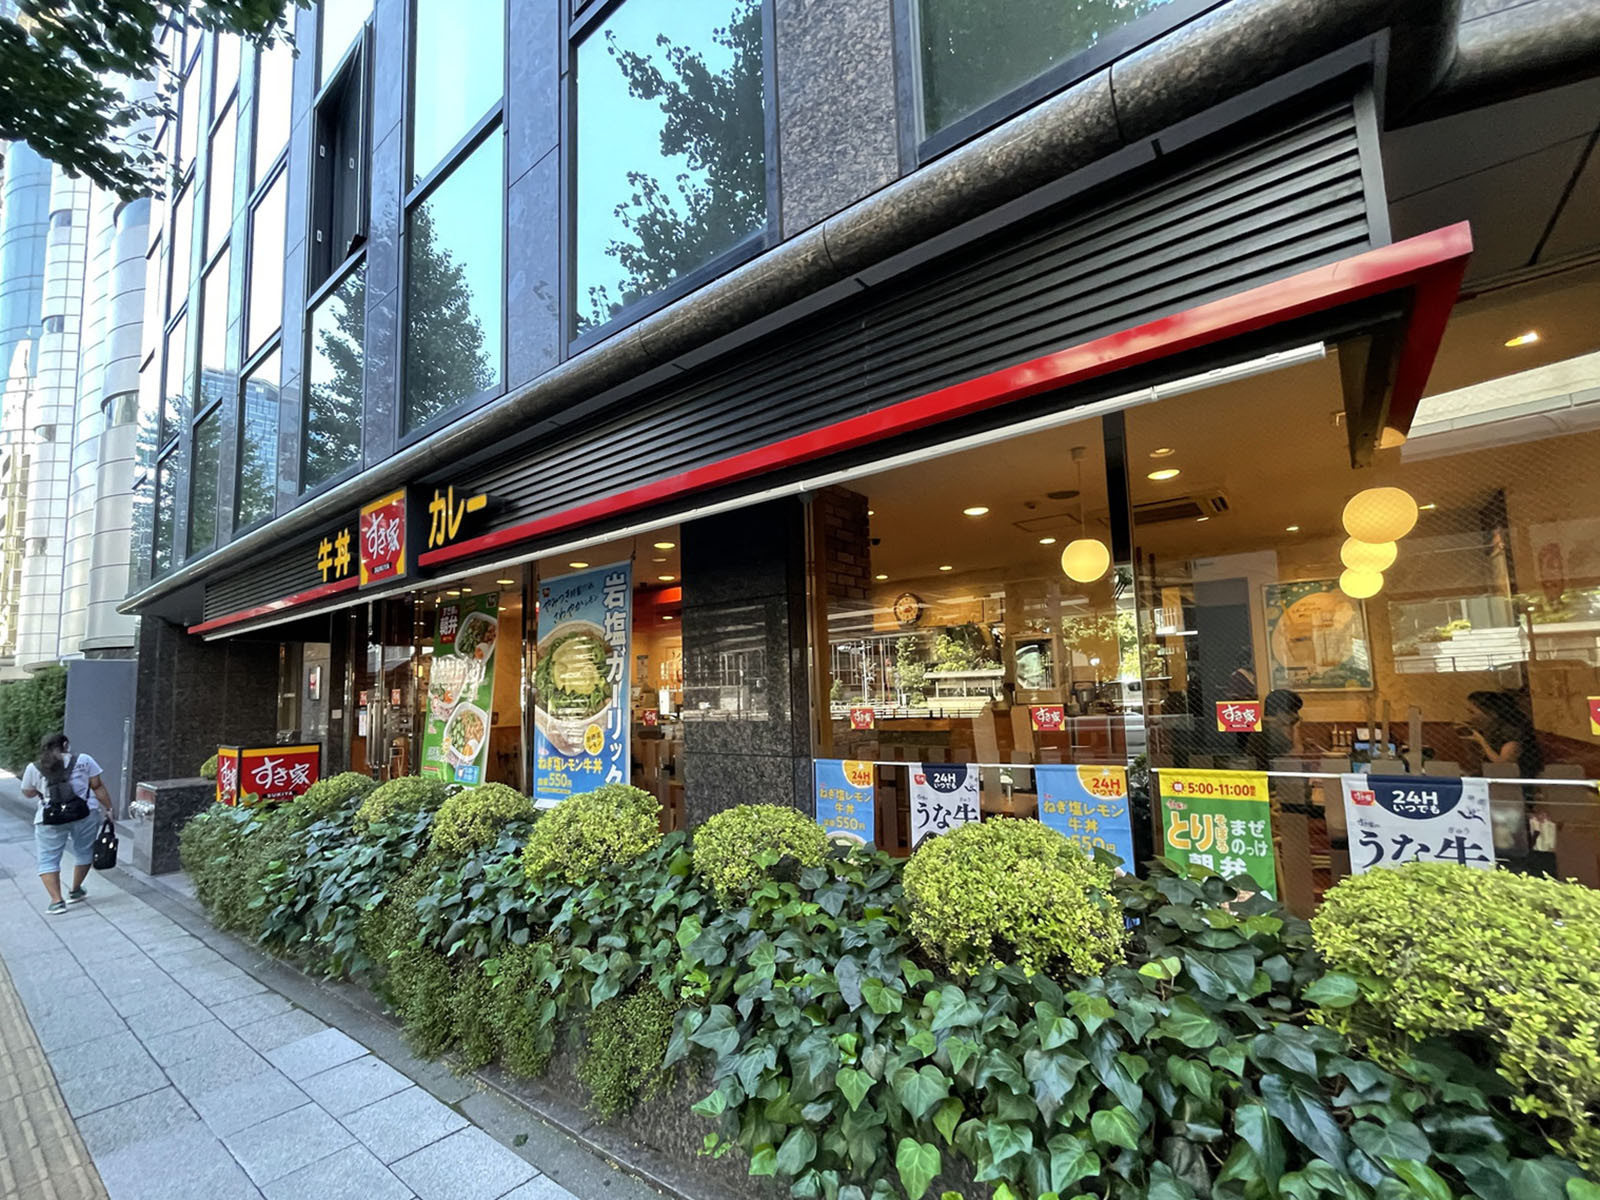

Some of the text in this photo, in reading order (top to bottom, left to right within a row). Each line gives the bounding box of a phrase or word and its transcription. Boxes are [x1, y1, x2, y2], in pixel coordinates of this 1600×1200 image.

[428, 485, 487, 549] カレー
[366, 512, 400, 561] すき家
[317, 528, 351, 583] 牛丼
[603, 572, 627, 784] 岩塩ガーリック
[1036, 707, 1062, 723] すき家
[1221, 704, 1256, 725] すき家
[251, 756, 311, 790] すき家
[537, 757, 604, 774] ねぎ塩レモン牛丼
[853, 770, 871, 780] 24H
[933, 773, 956, 783] 24H
[933, 782, 957, 790] いつでも
[1091, 777, 1121, 790] 24H
[1187, 782, 1249, 796] 5:00-11:00
[267, 790, 293, 799] SUKIYA
[819, 788, 872, 803] ねぎ塩レモン
[1091, 788, 1122, 797] いつでも
[1392, 790, 1438, 805] 24H
[834, 802, 855, 815] 牛丼
[917, 801, 979, 829] うな牛
[1043, 801, 1125, 818] ねぎ塩レモン
[1392, 804, 1440, 814] いつでも
[1068, 817, 1099, 834] 牛丼
[1167, 810, 1214, 852] とり
[1358, 830, 1490, 868] うな牛
